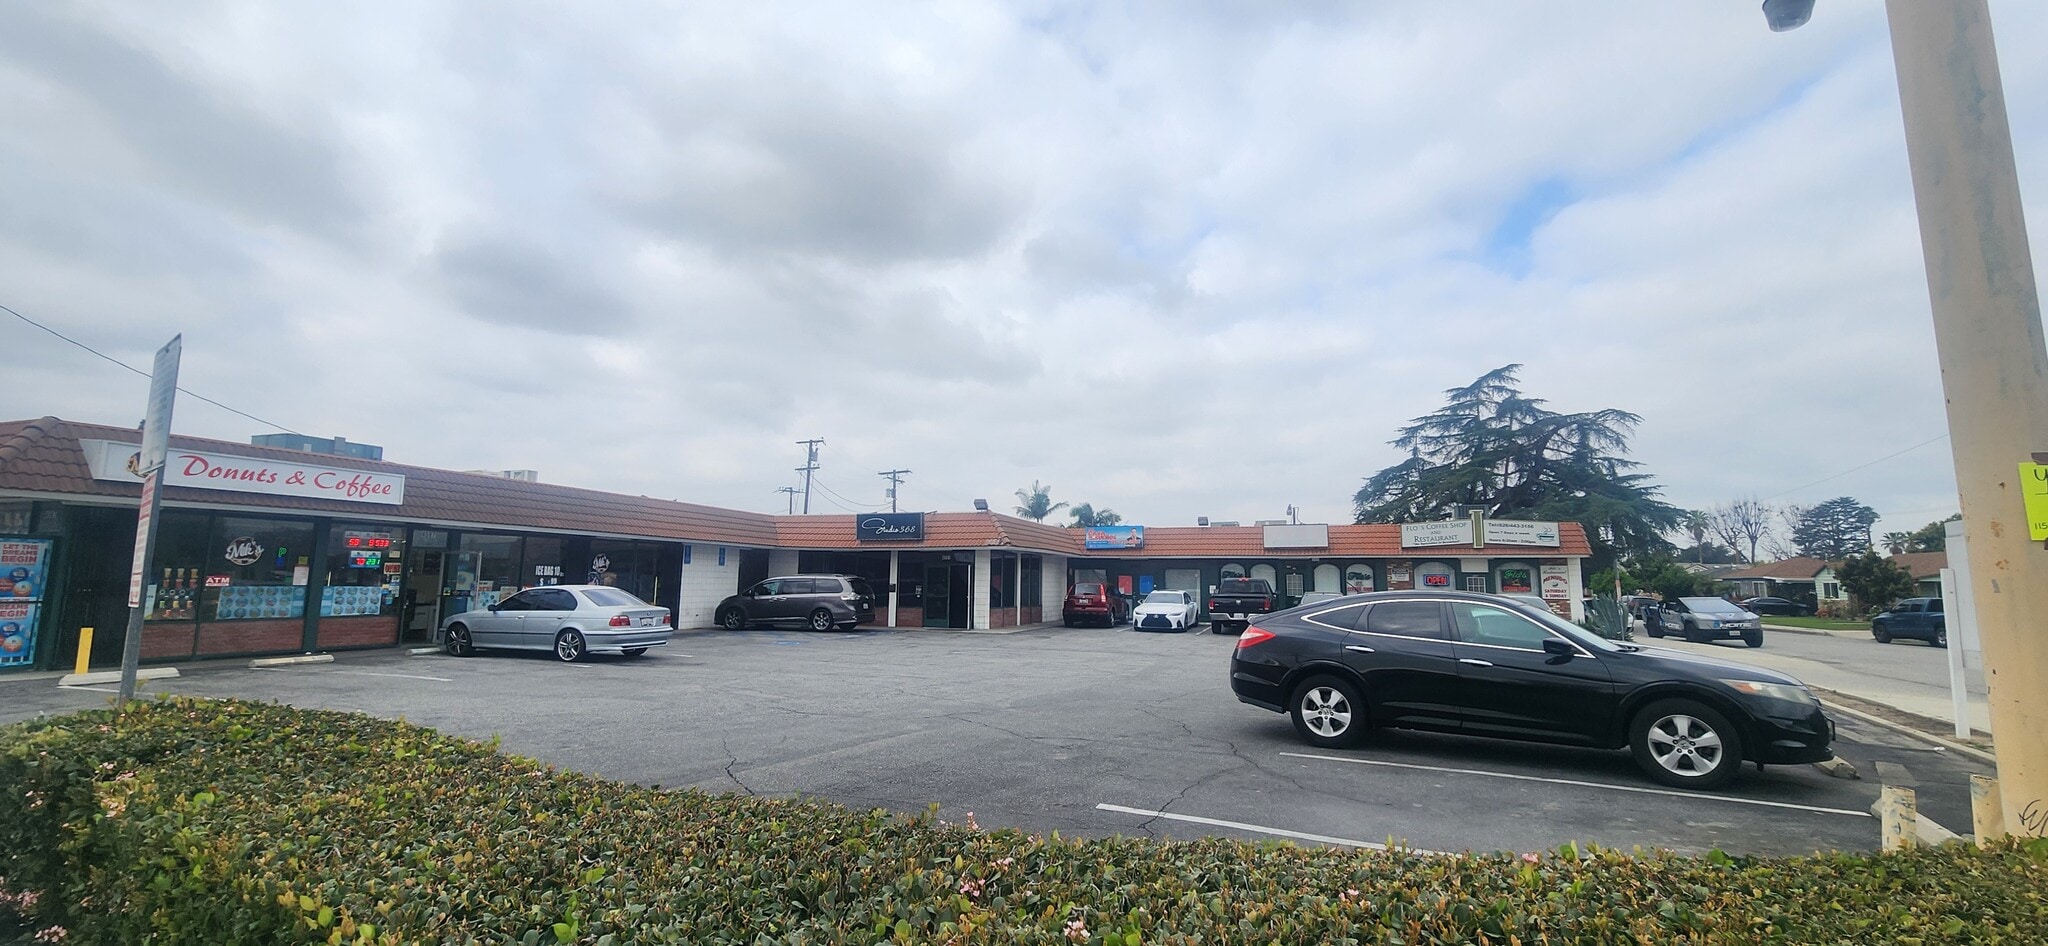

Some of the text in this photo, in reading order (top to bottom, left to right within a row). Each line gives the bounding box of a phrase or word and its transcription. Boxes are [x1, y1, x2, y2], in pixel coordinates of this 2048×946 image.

[178, 455, 391, 498] Donuts & Coffee
[1413, 534, 1458, 543] RESTAURANT
[1427, 576, 1448, 585] OPEN
